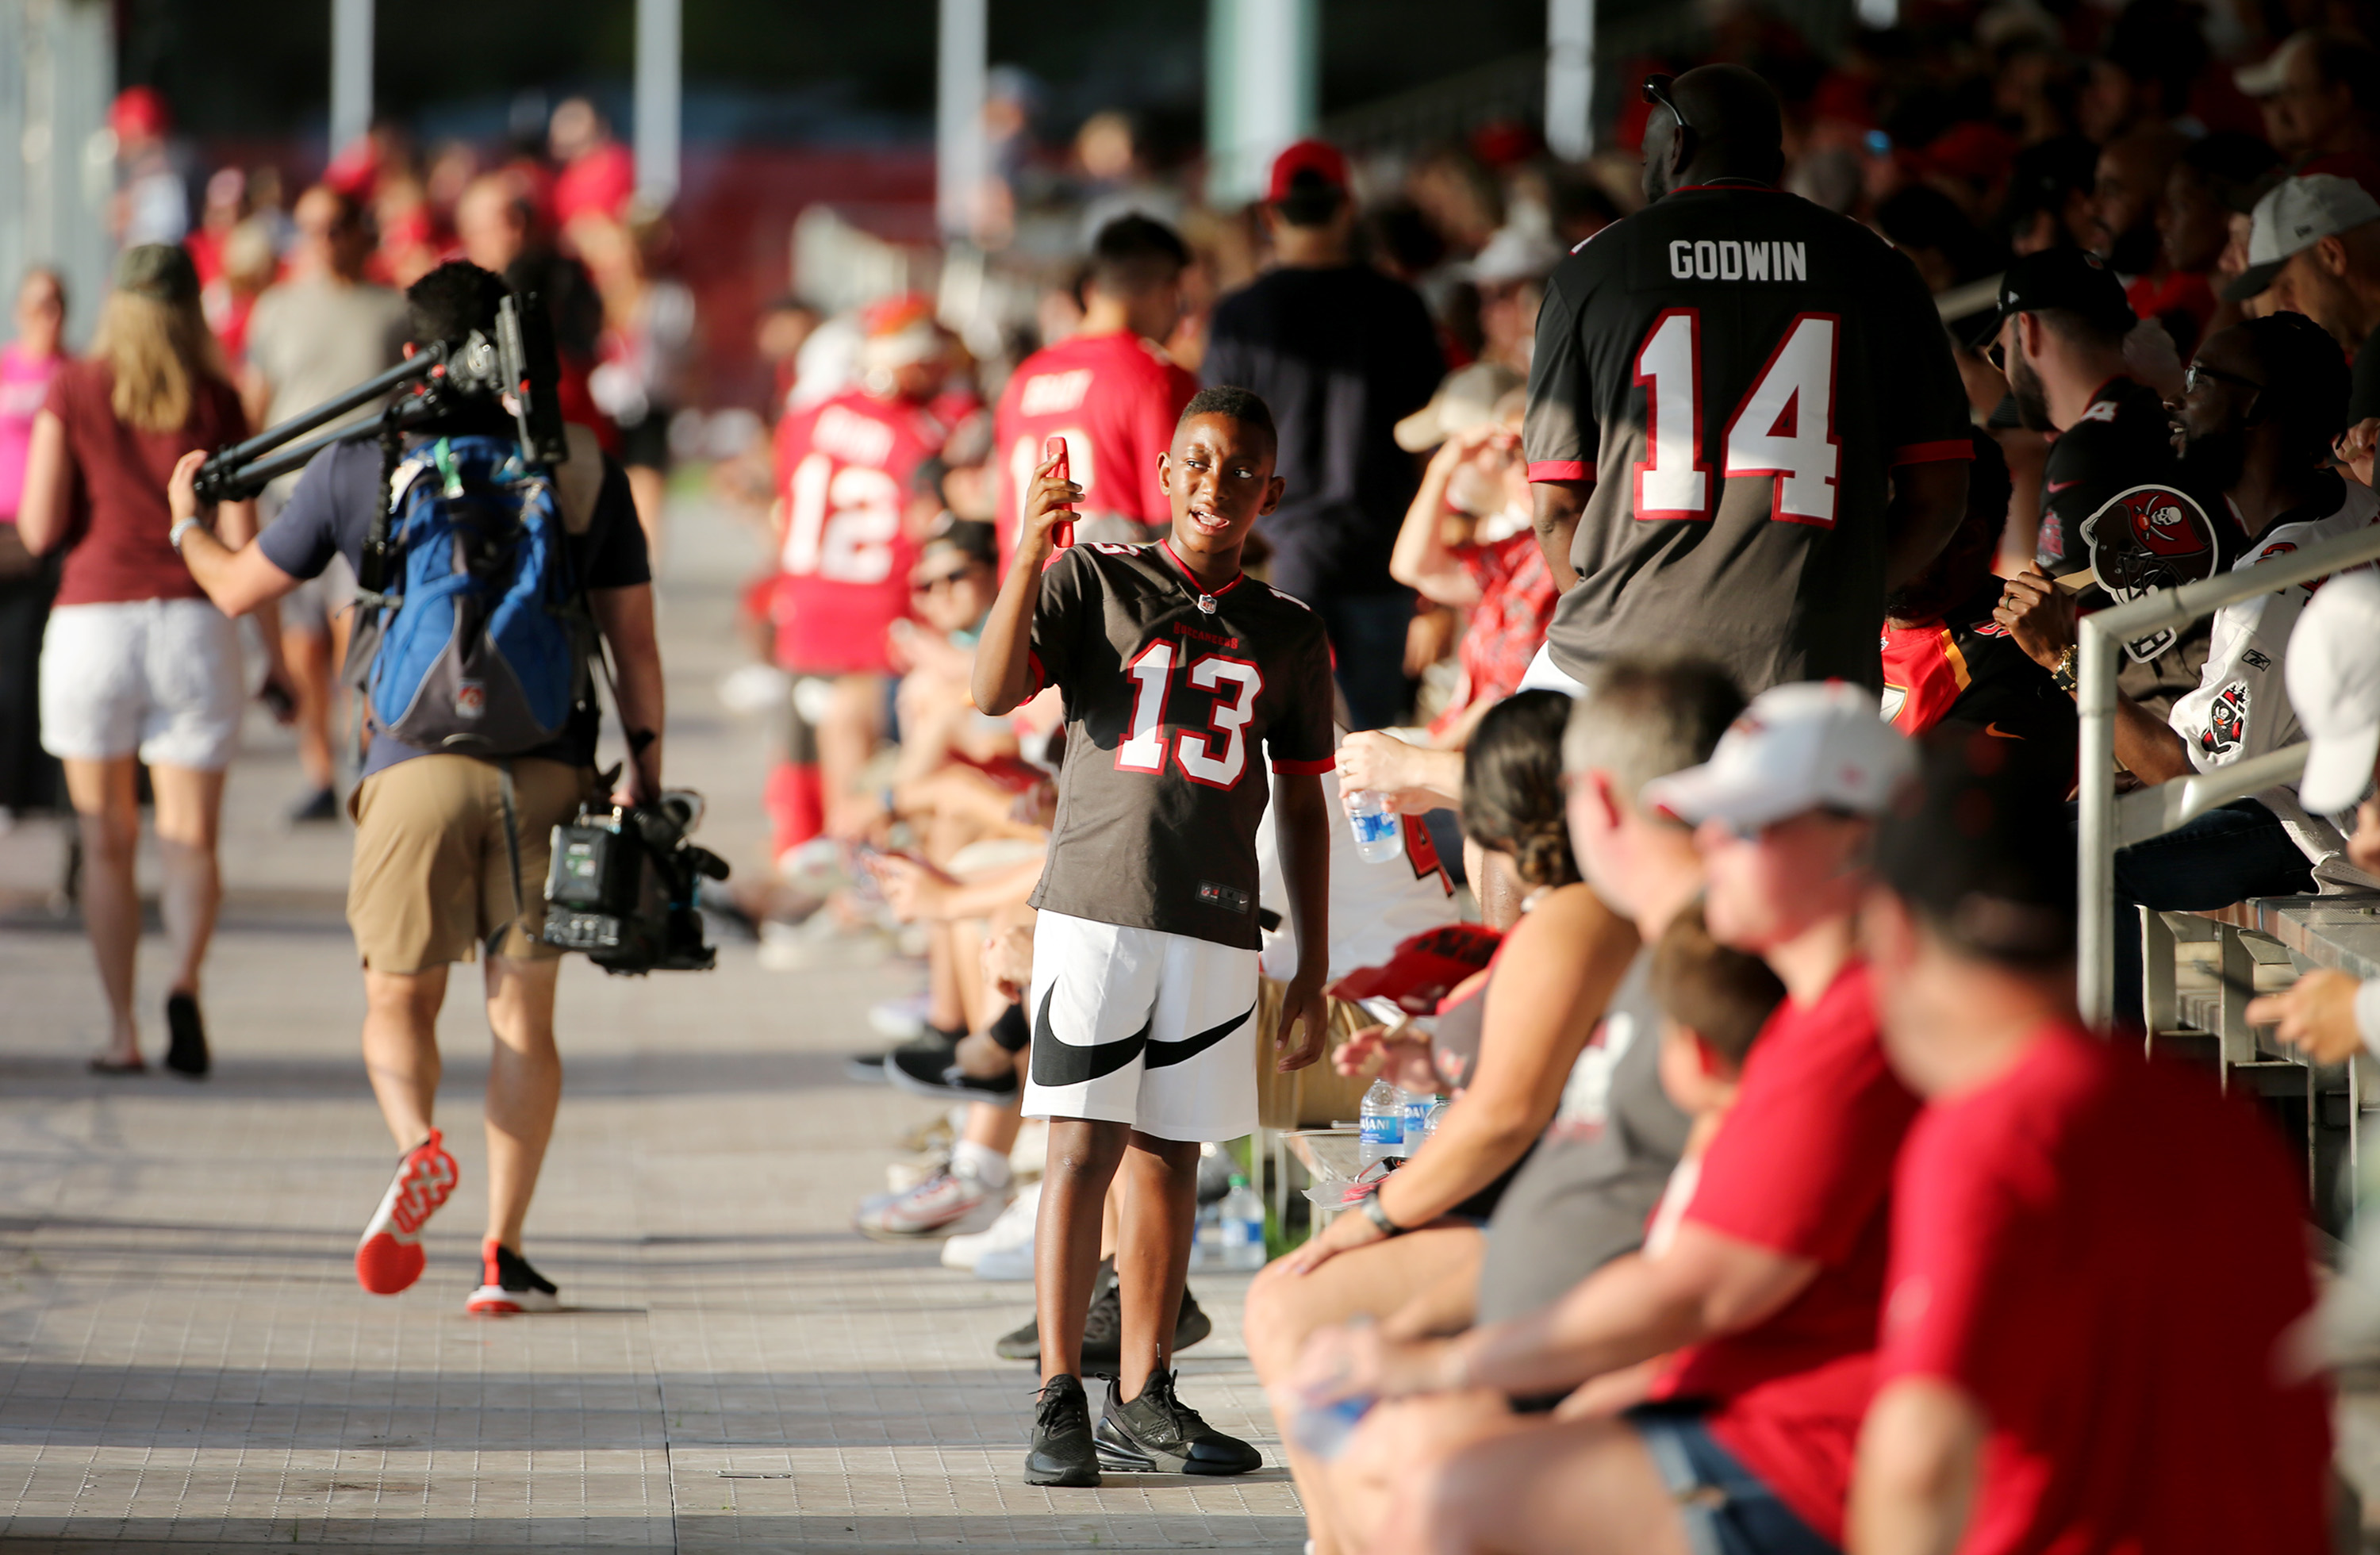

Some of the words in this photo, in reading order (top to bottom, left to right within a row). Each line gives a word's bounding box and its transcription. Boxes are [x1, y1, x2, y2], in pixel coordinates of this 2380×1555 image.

[1669, 240, 1807, 281] GODWIN
[1633, 306, 1842, 531] 14
[781, 451, 901, 585] 12
[1173, 621, 1239, 650] BUCCANEERS
[1114, 637, 1265, 792] 13
